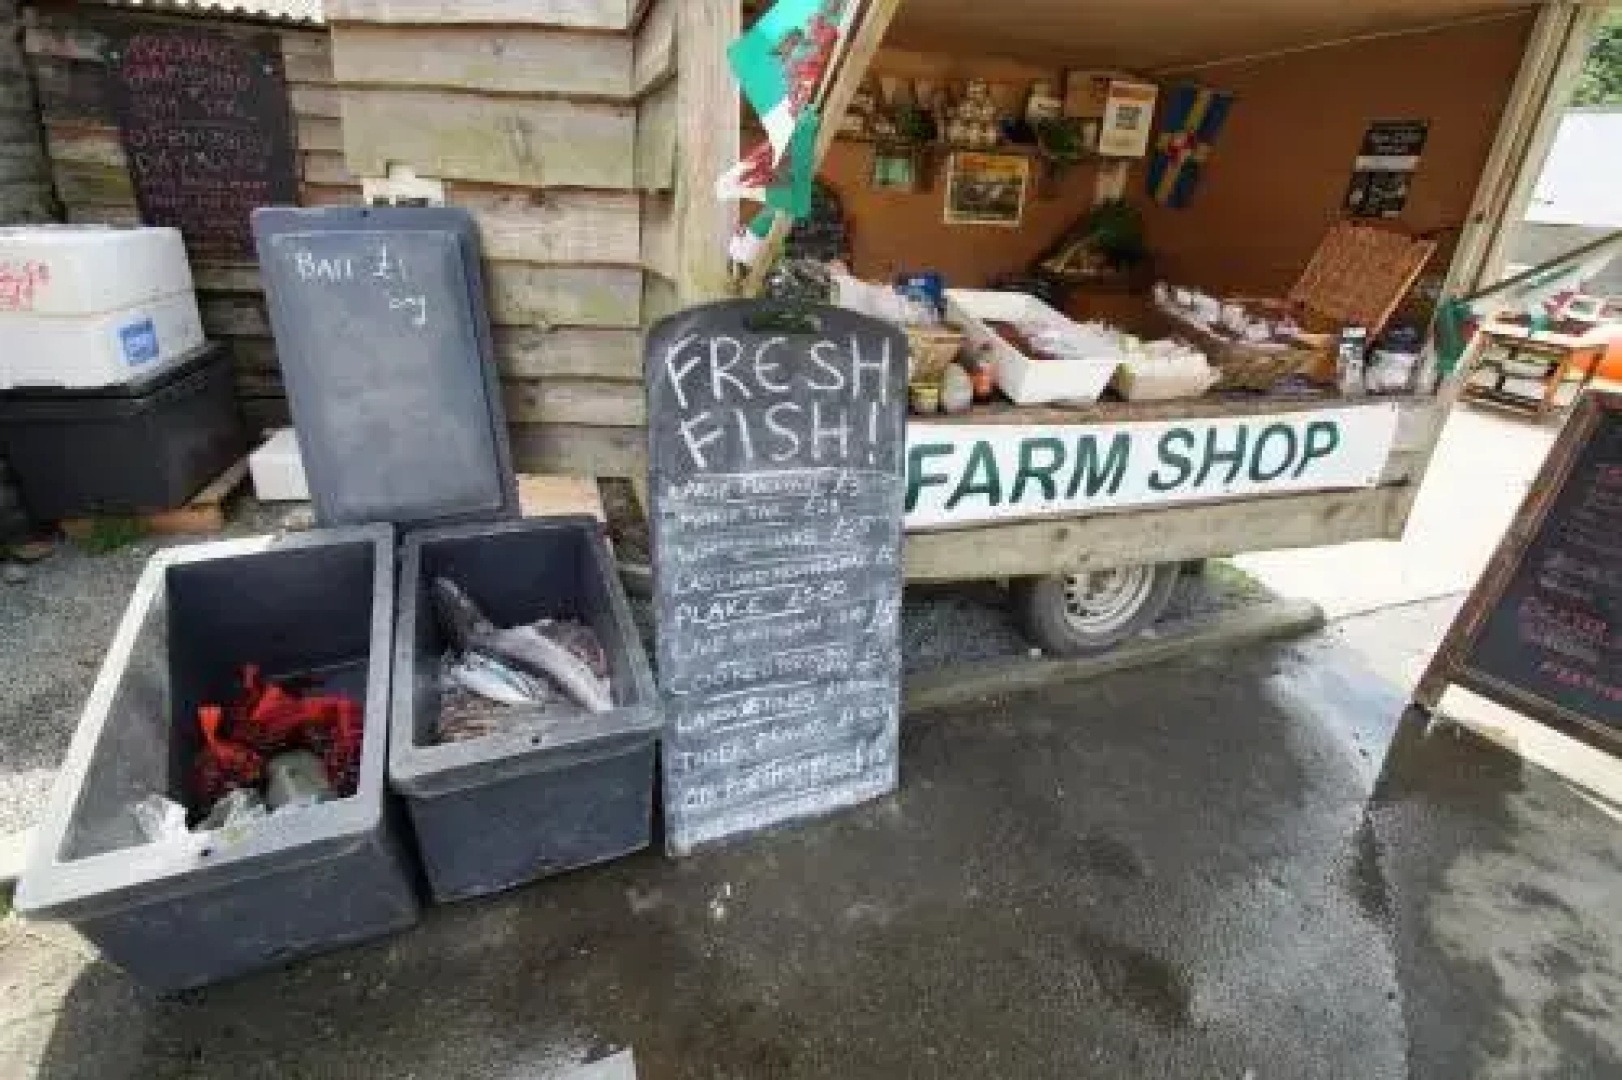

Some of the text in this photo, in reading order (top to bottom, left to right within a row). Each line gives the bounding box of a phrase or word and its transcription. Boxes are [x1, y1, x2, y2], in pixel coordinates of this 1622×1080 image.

[665, 333, 891, 409] FRESH
[679, 400, 878, 468] FISH!
[904, 420, 1341, 513] FARM SHOP
